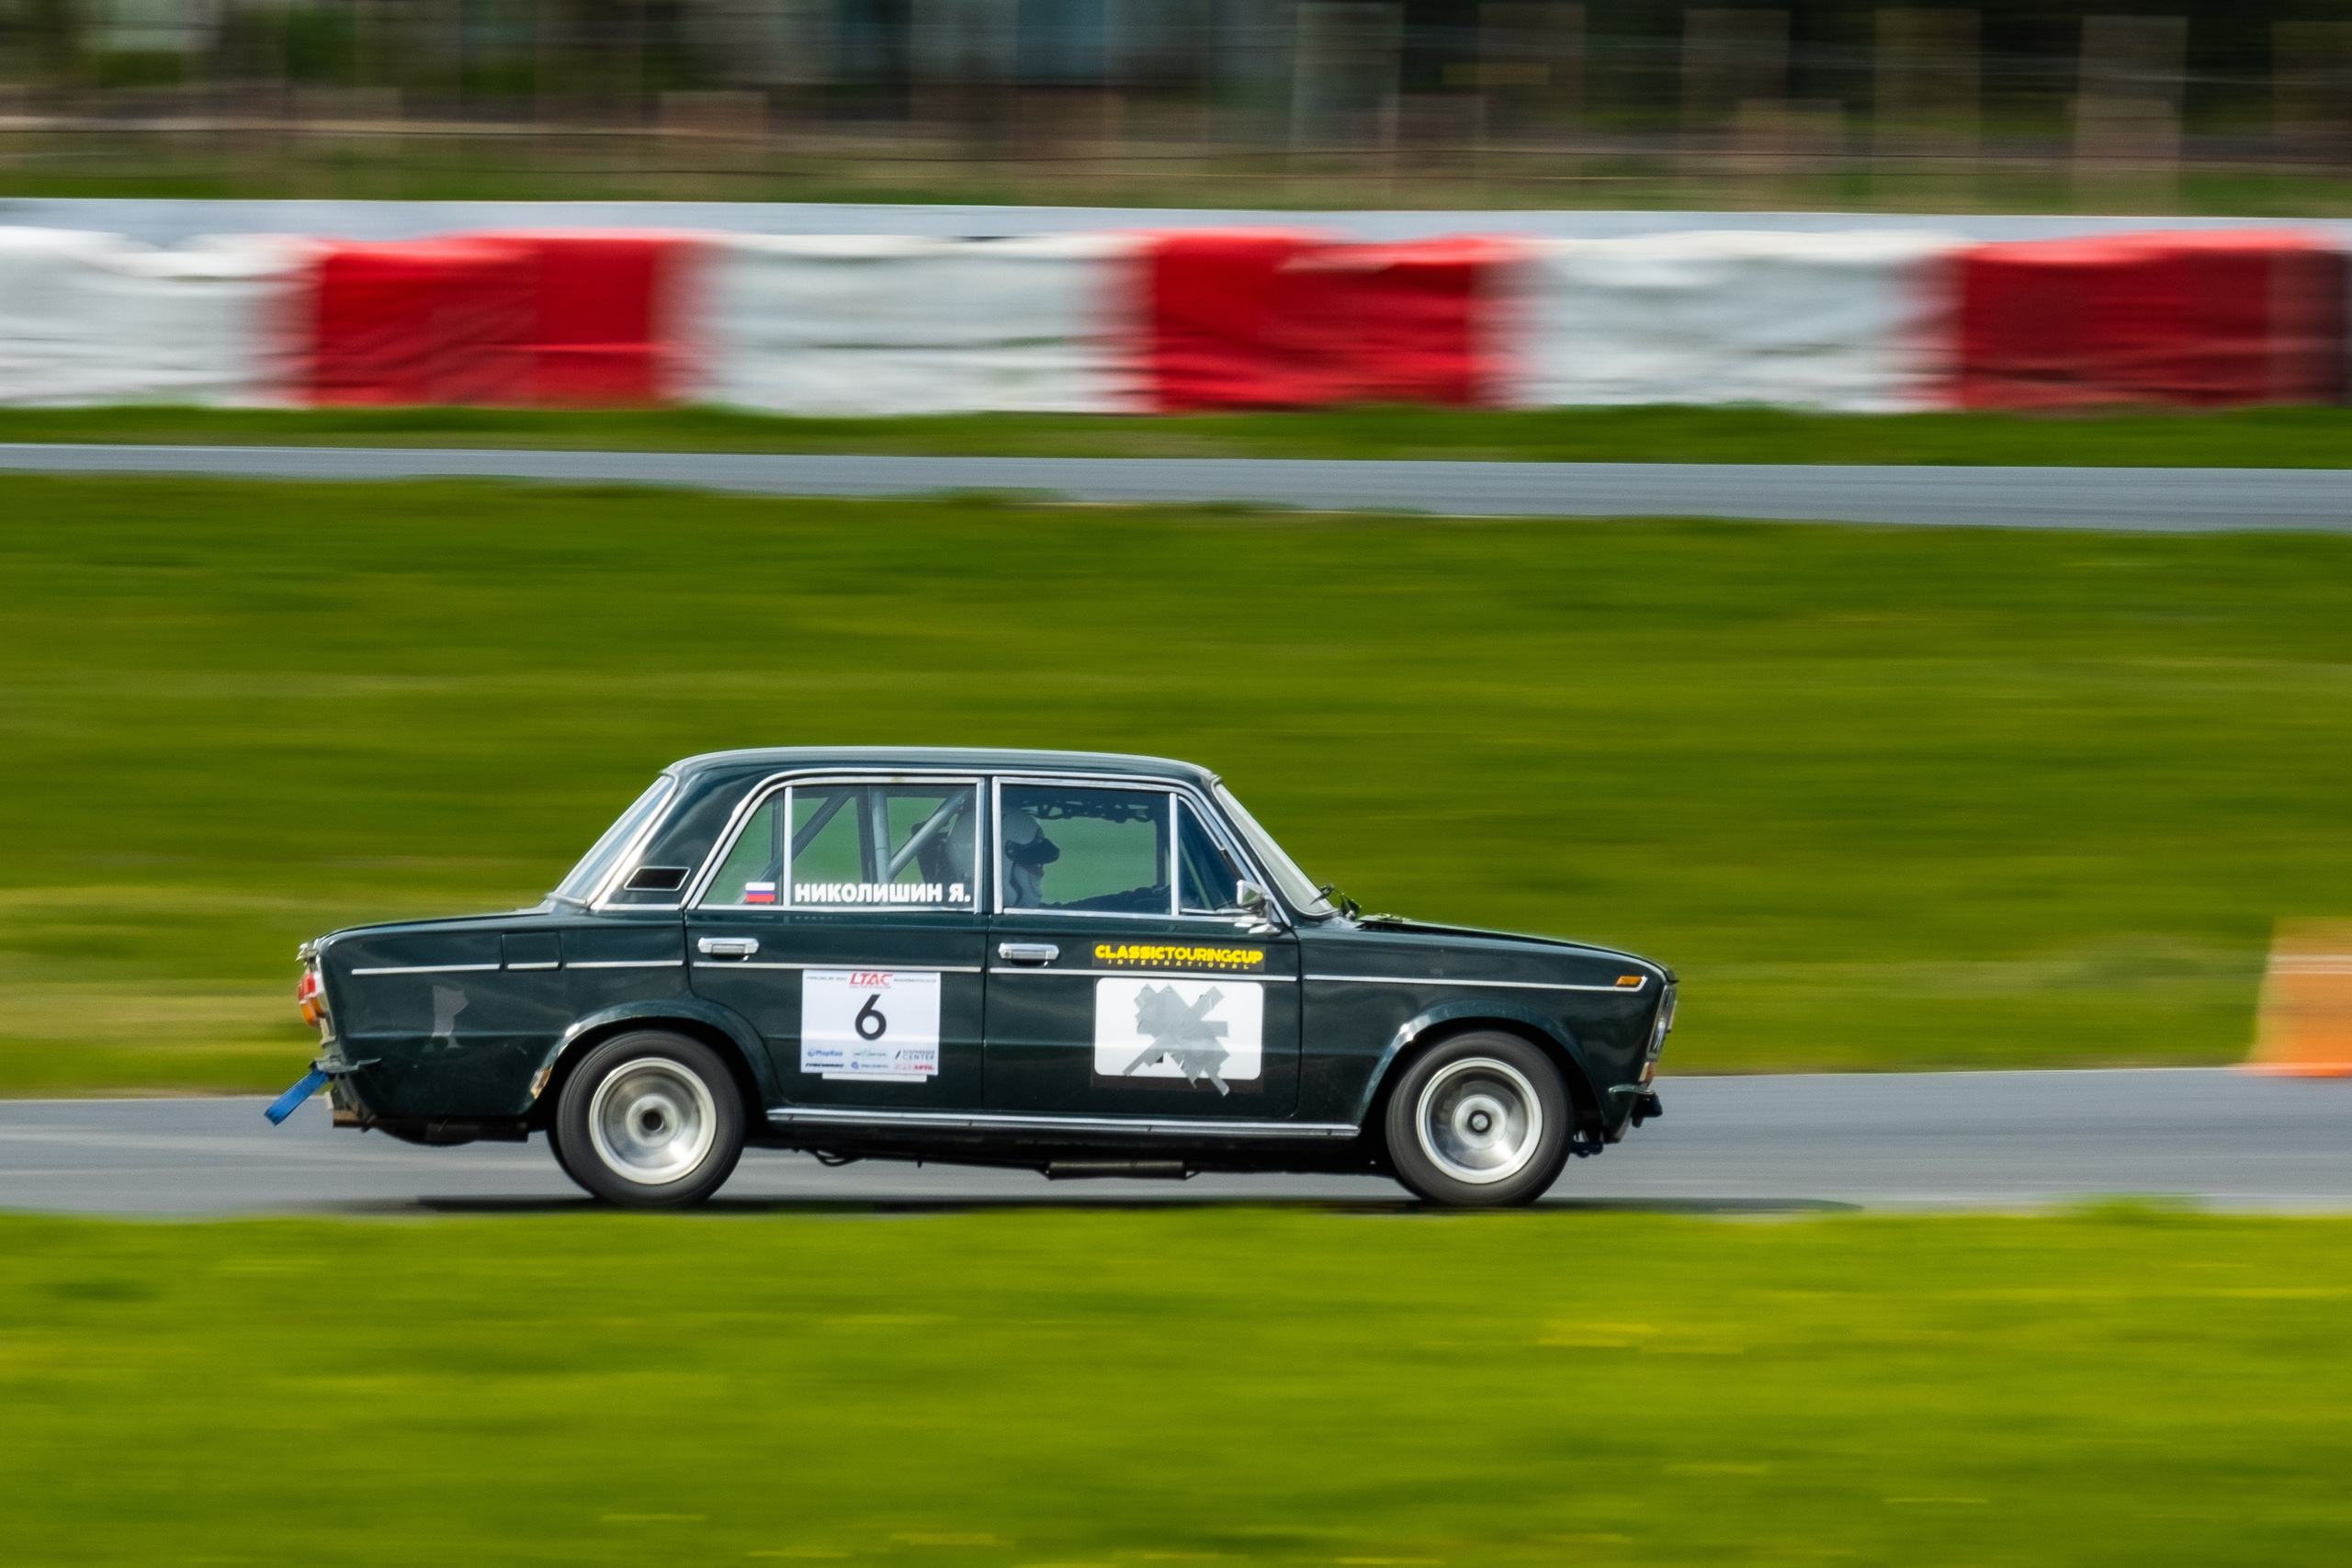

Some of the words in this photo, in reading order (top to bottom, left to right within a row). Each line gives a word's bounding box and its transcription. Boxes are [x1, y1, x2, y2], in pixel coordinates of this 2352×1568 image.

[795, 883, 943, 903] НИКОЛИШИН
[948, 883, 971, 903] Я.
[1107, 959, 1250, 970] INTERNATIONAL
[850, 973, 894, 986] LTAC
[855, 994, 887, 1041] 6
